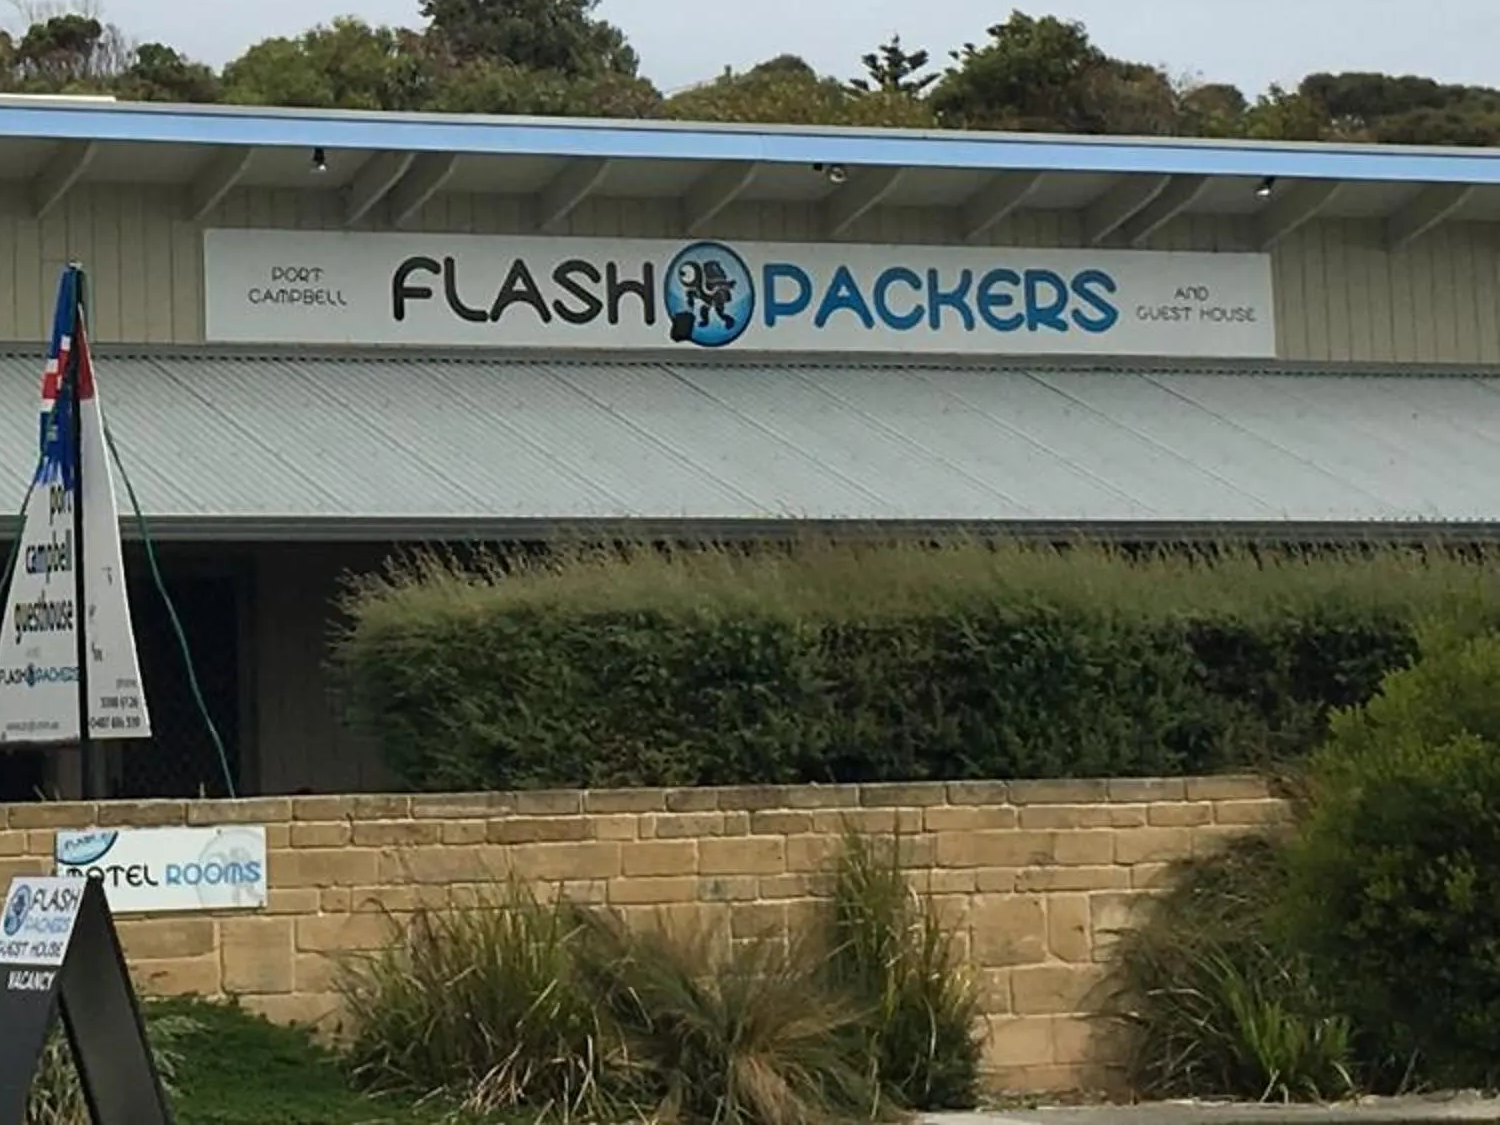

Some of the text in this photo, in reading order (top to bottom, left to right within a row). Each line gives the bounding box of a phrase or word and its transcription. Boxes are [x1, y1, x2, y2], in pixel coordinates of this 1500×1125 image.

[271, 266, 325, 283] PORT
[247, 287, 348, 306] CAMPBELL
[392, 255, 1120, 333] FLASH PACKERS
[1173, 285, 1210, 302] AND
[1135, 304, 1257, 323] GUEST HOUSE
[26, 528, 73, 584] campbell
[13, 589, 74, 645] guesthouse
[165, 860, 262, 885] ROOMS
[27, 887, 81, 911] FLASH
[30, 941, 64, 958] HOUSE
[7, 969, 57, 990] VACANCY
